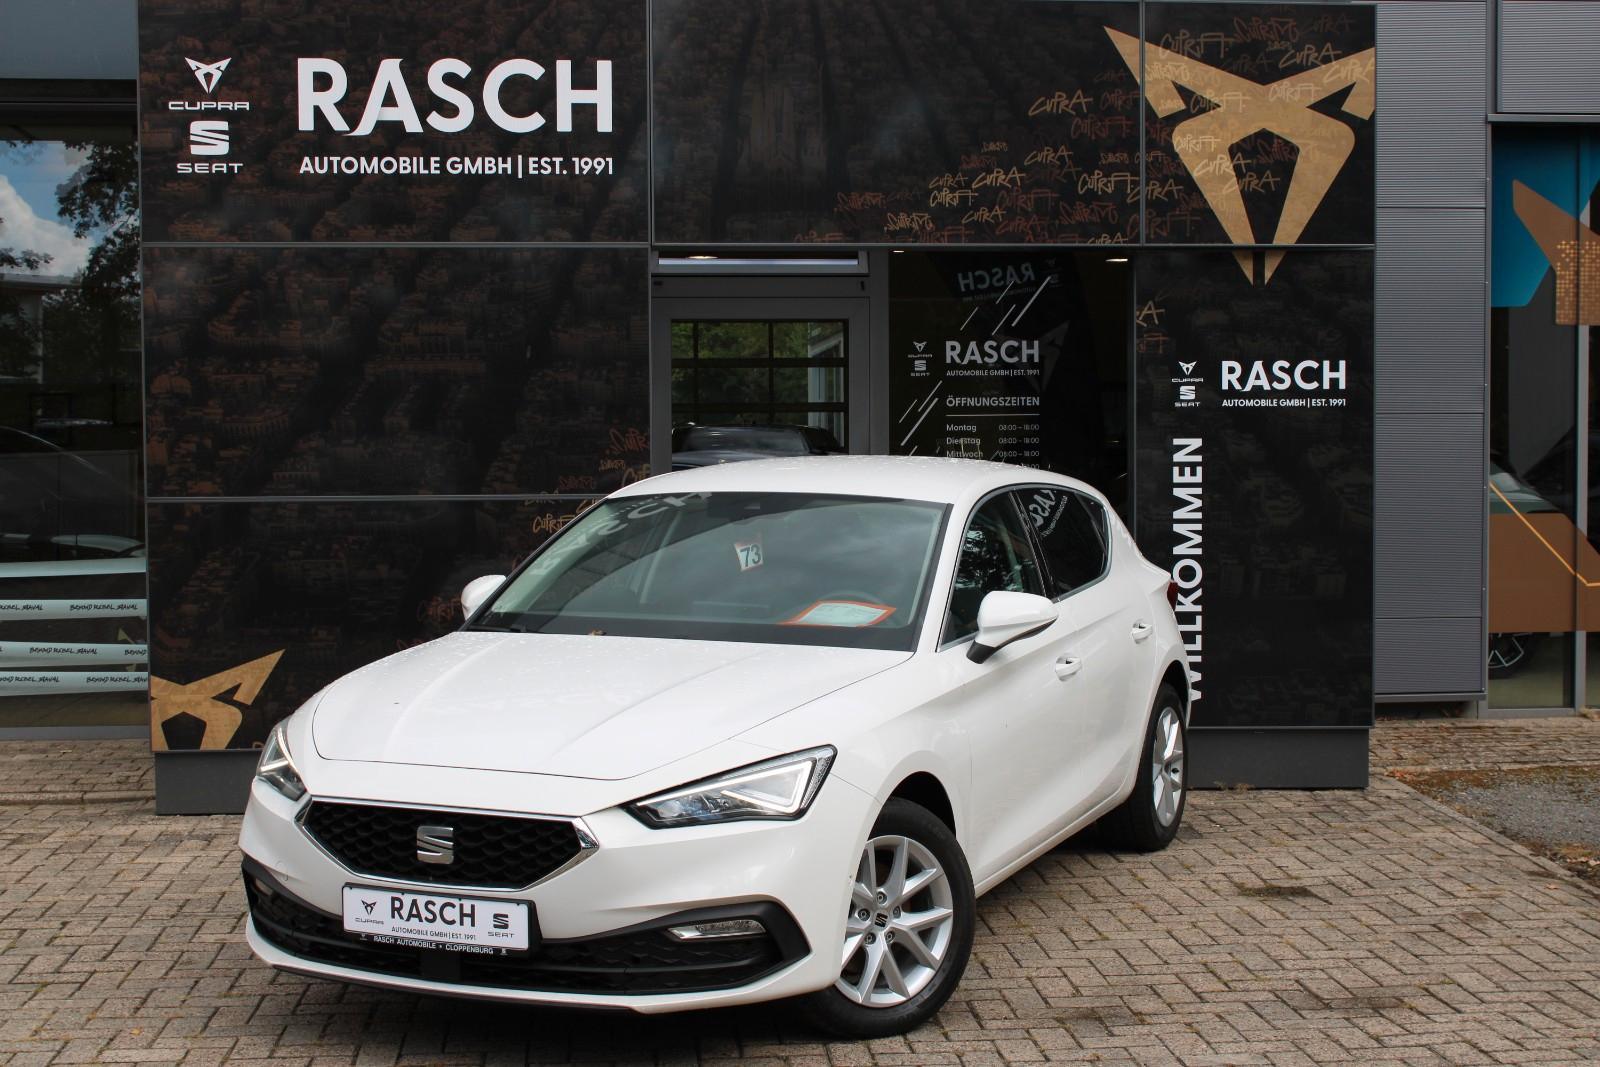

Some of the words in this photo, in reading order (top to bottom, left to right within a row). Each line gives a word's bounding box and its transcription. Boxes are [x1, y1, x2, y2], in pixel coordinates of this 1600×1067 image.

[297, 57, 613, 137] RASCH
[168, 101, 250, 111] CUPRA
[176, 163, 244, 174] SEAT
[299, 156, 441, 176] AUTOMOBILE
[446, 156, 512, 176] GMBH
[528, 156, 568, 176] EST.
[572, 156, 614, 176] 1991
[945, 340, 1040, 365] RASCH
[1221, 359, 1346, 391] RASCH
[946, 395, 1040, 407] ÖFFNUNGSZEITEN
[1222, 398, 1278, 407] AUTOMOBILE
[1279, 398, 1306, 407] GMBH
[1311, 398, 1328, 407] EST.
[1329, 398, 1346, 407] 1991
[946, 424, 977, 433] Montag
[946, 437, 981, 445] Dienstag
[946, 450, 983, 458] Mittwoch
[740, 543, 762, 568] 73
[390, 895, 476, 928] RASCH
[391, 926, 429, 937] AUTOMOBILE
[429, 929, 448, 938] GMBH
[464, 933, 477, 941] 1991
[487, 931, 515, 939] SEAT
[373, 935, 395, 944] RASCH
[396, 937, 436, 949] AUTOMOBILE
[445, 943, 494, 955] CLOPPENBURG
